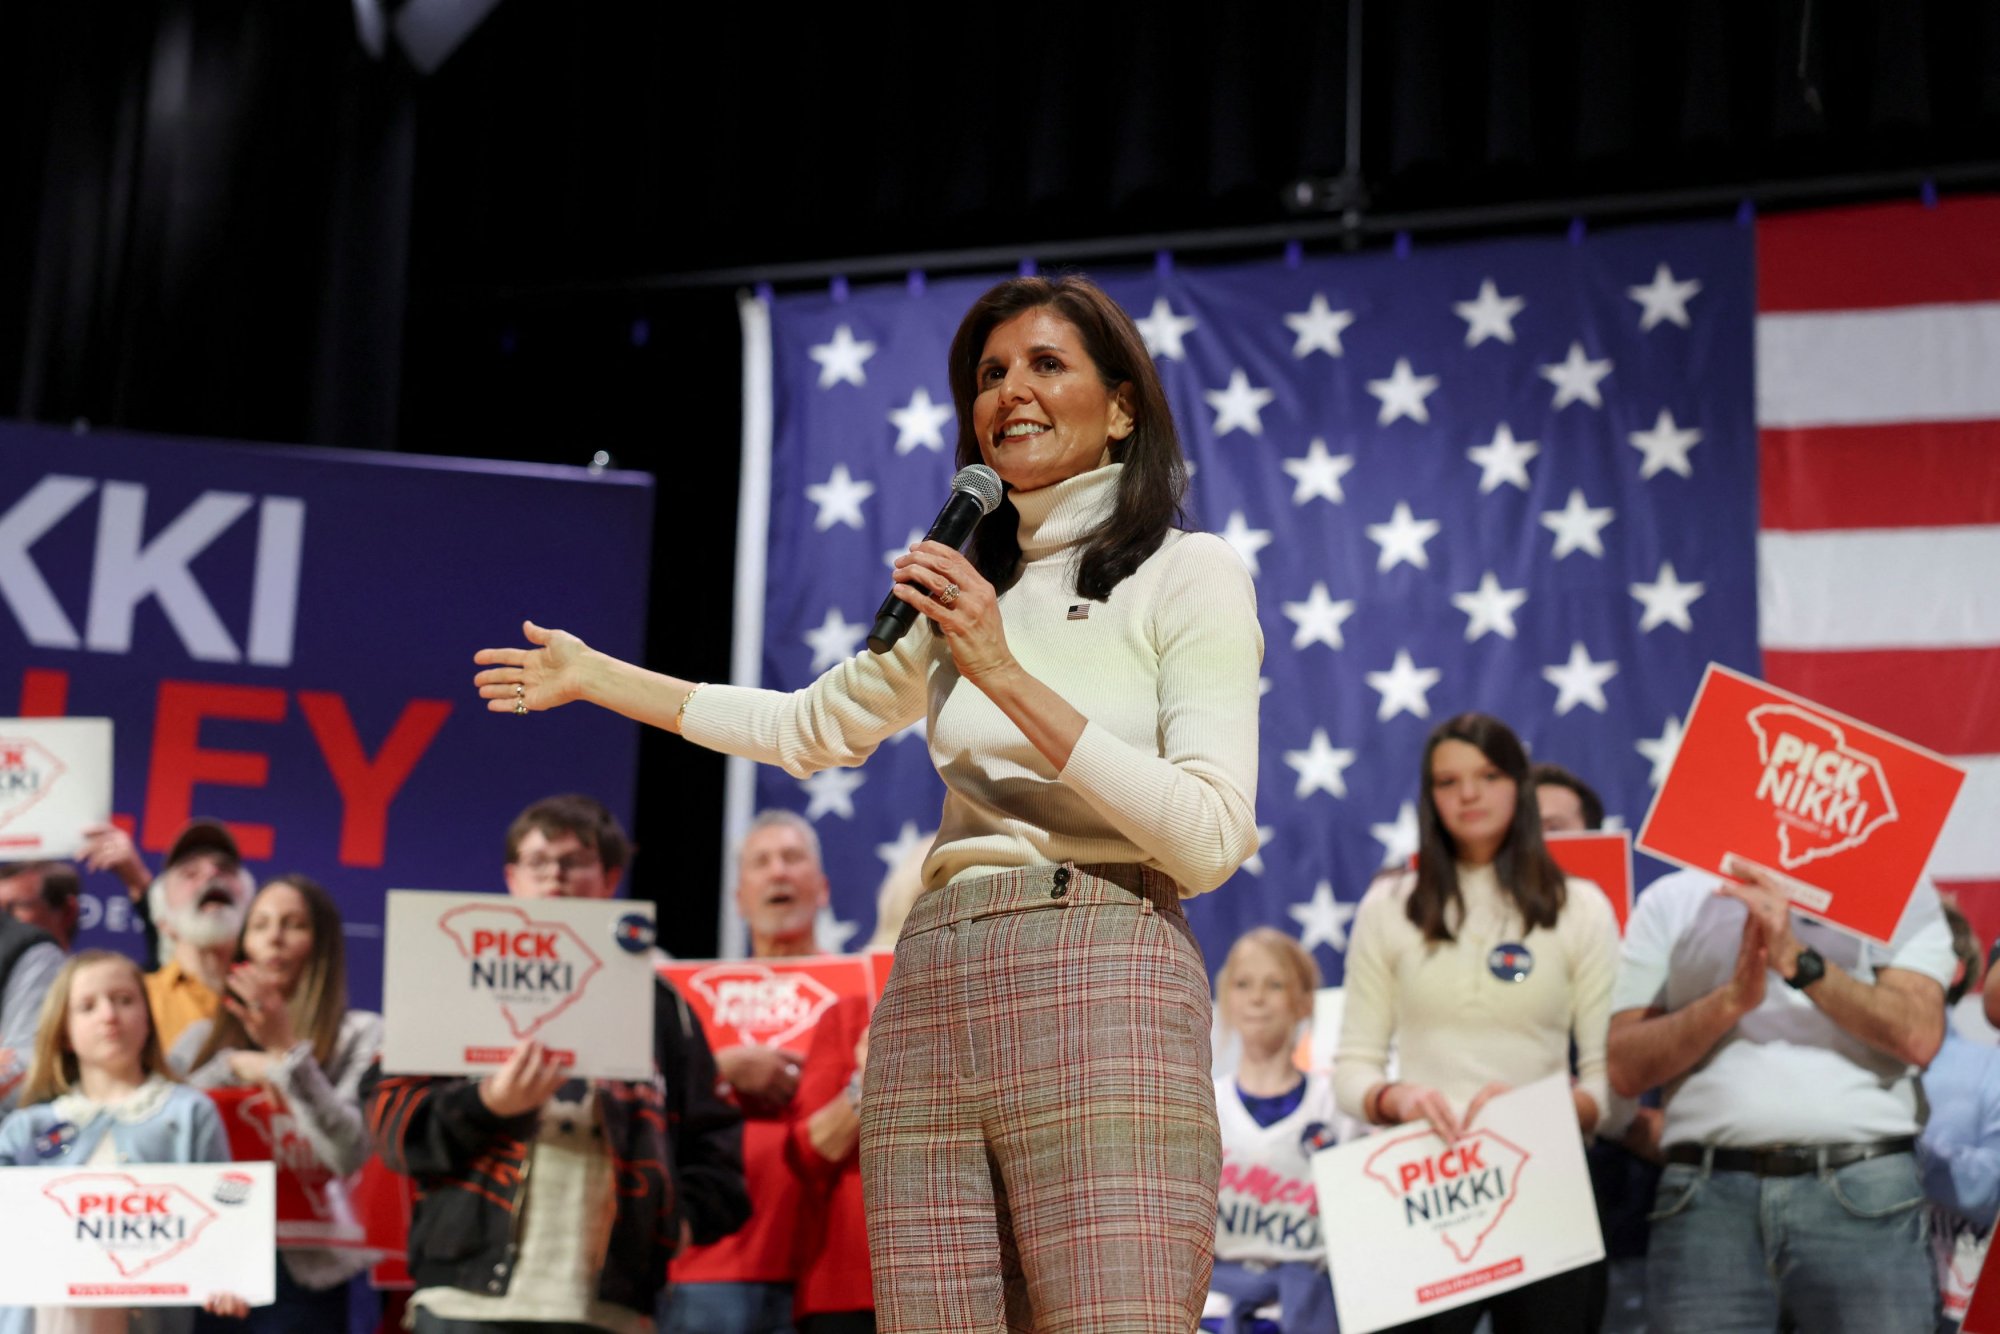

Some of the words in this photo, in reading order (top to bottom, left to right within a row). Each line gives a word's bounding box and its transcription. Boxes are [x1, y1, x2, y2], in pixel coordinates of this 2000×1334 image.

[1770, 731, 1869, 799] PICK
[1755, 765, 1869, 836] NIKKI
[473, 929, 558, 960] PICK
[471, 960, 573, 992] NIKKI
[718, 980, 798, 1003] PICK
[714, 998, 812, 1026] NIKKI
[1399, 1140, 1485, 1192] PICK
[78, 1194, 170, 1215] PICK
[1404, 1167, 1505, 1227] NIKKI
[76, 1217, 185, 1240] NIKKI
